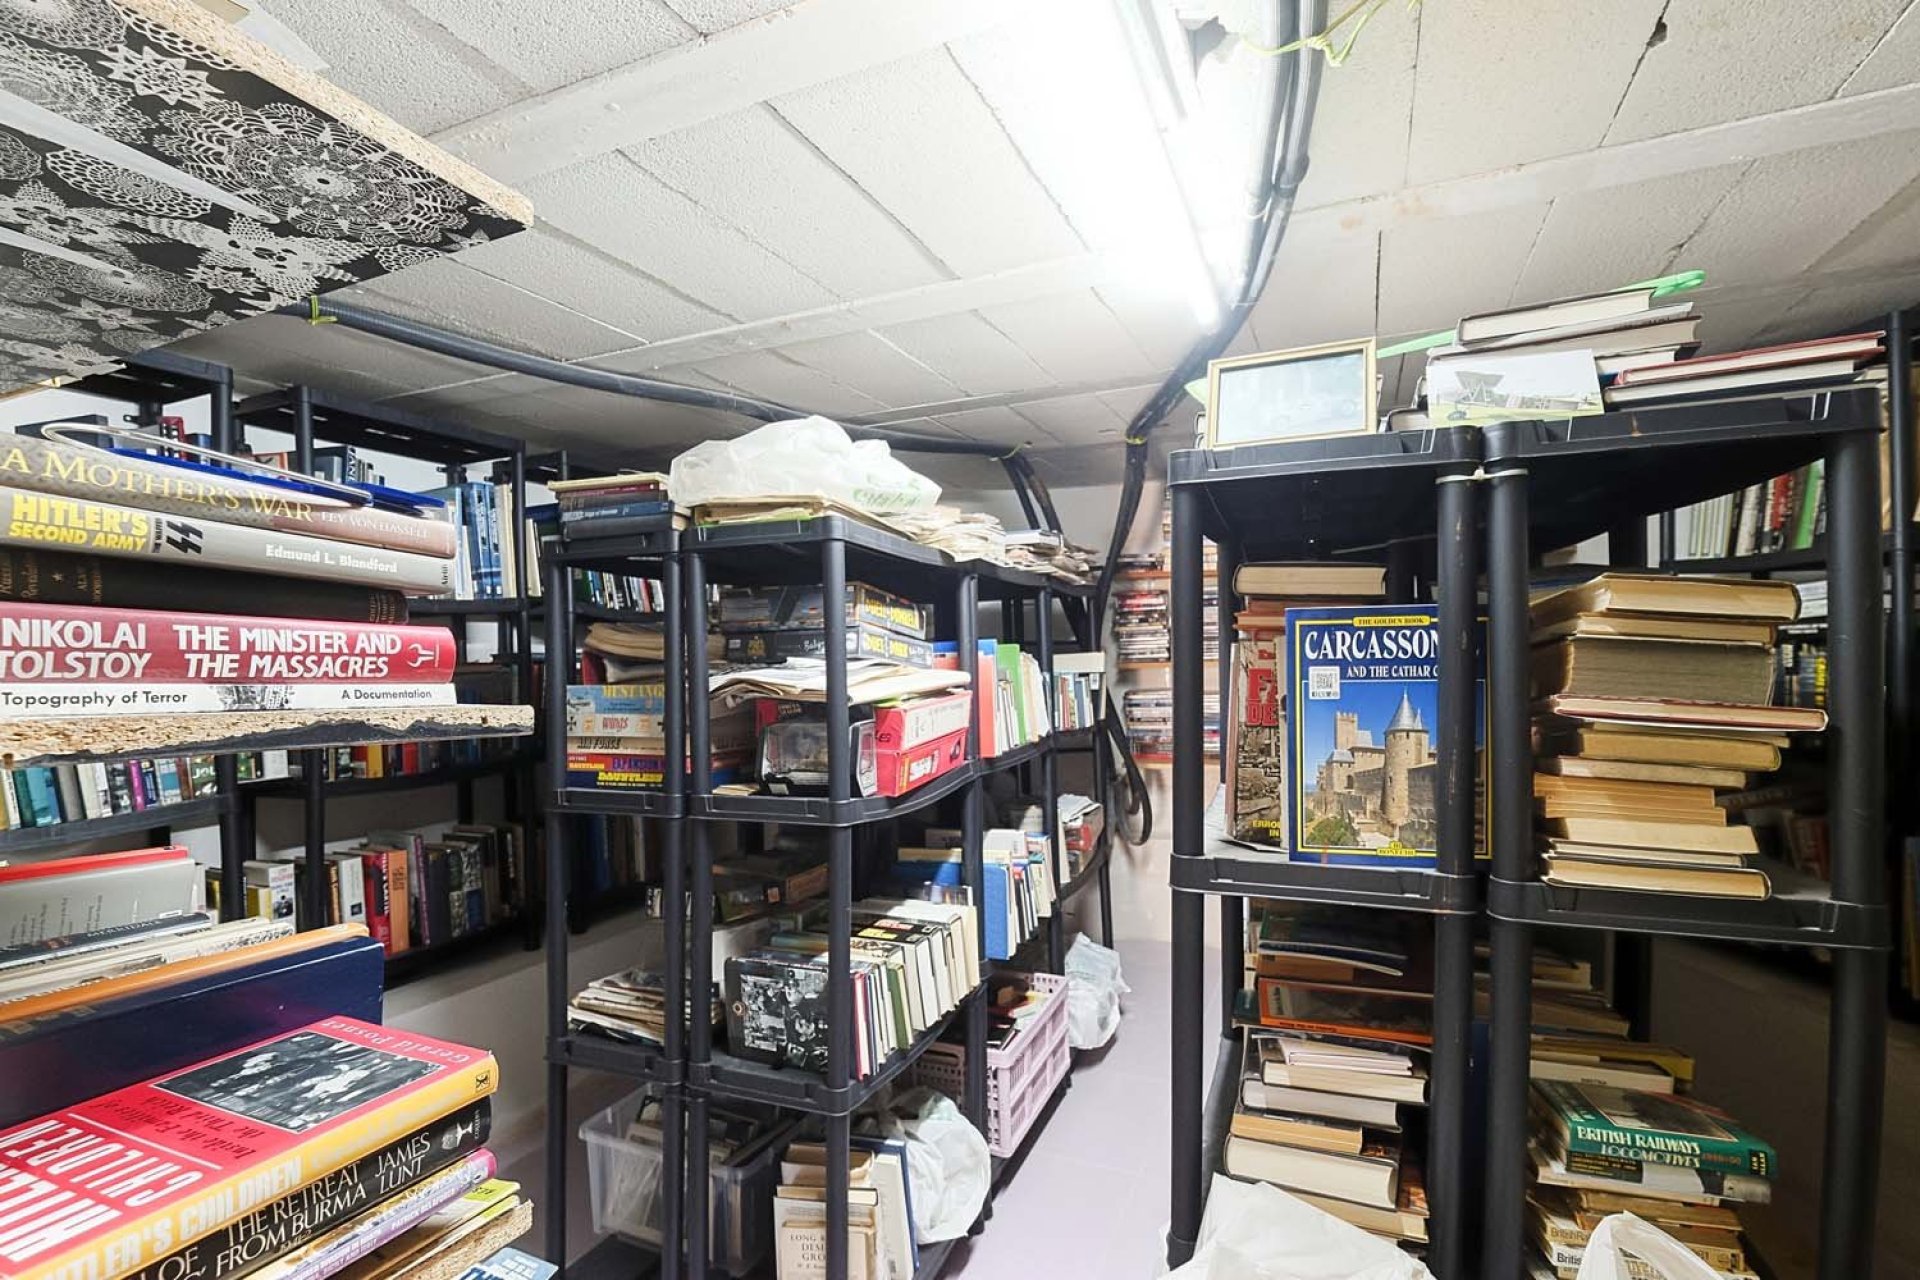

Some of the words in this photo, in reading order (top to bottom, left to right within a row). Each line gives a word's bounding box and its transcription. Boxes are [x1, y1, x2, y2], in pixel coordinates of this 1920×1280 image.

[0, 448, 31, 474] A
[41, 451, 240, 509] MOTHER'S
[249, 491, 313, 522] WAR
[12, 493, 149, 537] HITLER'S
[9, 521, 87, 545] SECOND
[92, 531, 147, 552] ARMY
[265, 543, 321, 564] Edmund
[339, 552, 398, 573] Blandford
[1, 617, 147, 650] NIKOLAI
[172, 624, 231, 651] THE
[239, 627, 346, 655] MINISTER
[355, 633, 402, 656] AND
[0, 651, 152, 680] TOLSTOY
[184, 653, 240, 678] THE
[250, 655, 389, 678] MASSACRES
[1347, 665, 1367, 678] AND
[1369, 665, 1390, 678] THE
[1391, 664, 1432, 678] CATHAR
[1, 690, 120, 709] Topography
[121, 690, 139, 704] of
[142, 691, 188, 704] Terror
[342, 690, 351, 700] A
[354, 687, 433, 700] Documentation
[319, 1020, 395, 1044] Posner
[392, 1039, 472, 1065] Gerald
[185, 1110, 235, 1132] Third
[234, 1126, 265, 1141] the
[202, 1136, 257, 1160] Inside
[374, 1132, 432, 1177] JAMES
[1577, 1125, 1632, 1145] BRITISH
[1635, 1132, 1701, 1155] RAILWAYS
[1601, 1143, 1701, 1168] LOCOMOTIVES
[379, 1155, 425, 1194] LUNT
[225, 1207, 268, 1247] THE
[274, 1161, 361, 1221] RETREAT
[216, 1229, 287, 1278] FROM
[292, 1186, 367, 1239] BURMA
